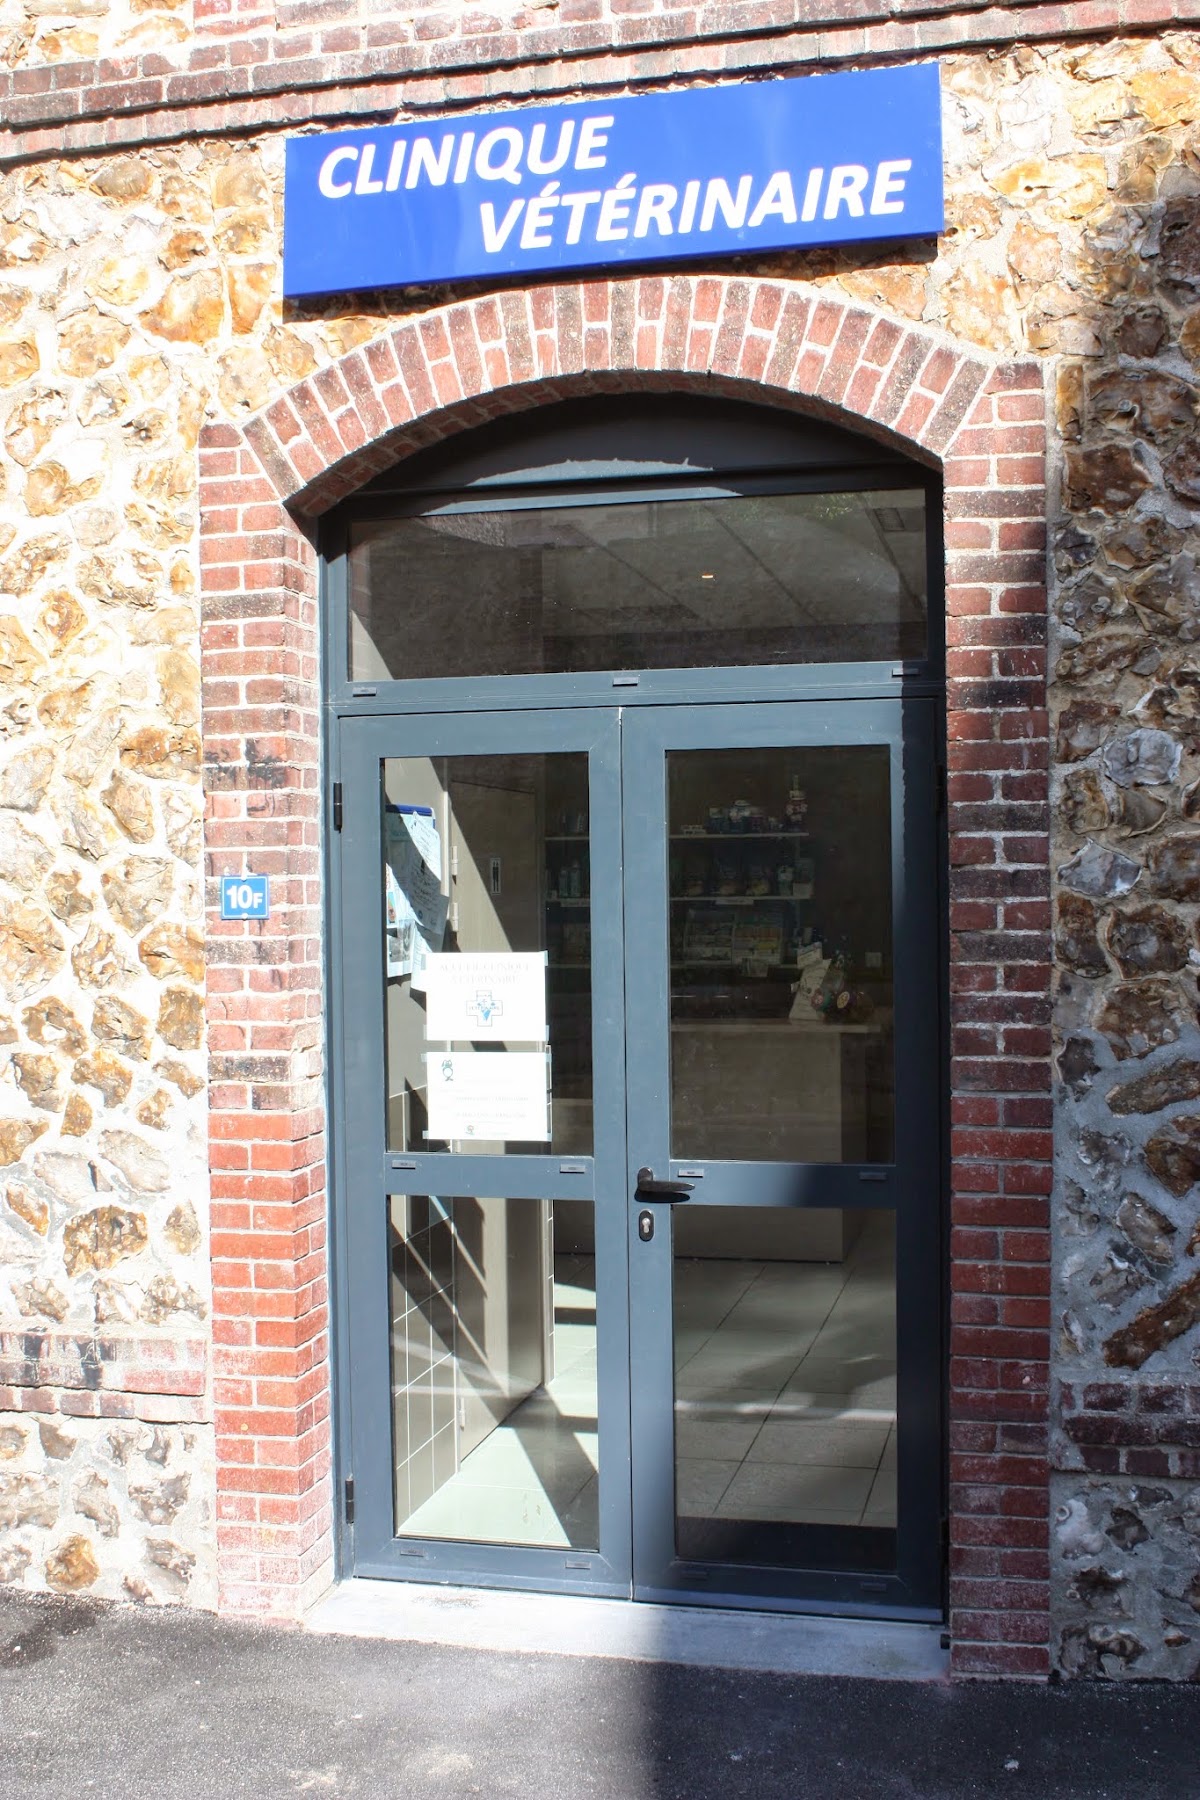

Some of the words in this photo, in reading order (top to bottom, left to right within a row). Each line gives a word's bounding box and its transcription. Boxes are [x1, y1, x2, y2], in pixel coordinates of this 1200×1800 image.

[317, 114, 615, 199] CLINIQUE
[478, 157, 913, 254] VÉTÉRINAIRE
[226, 884, 263, 909] 10F
